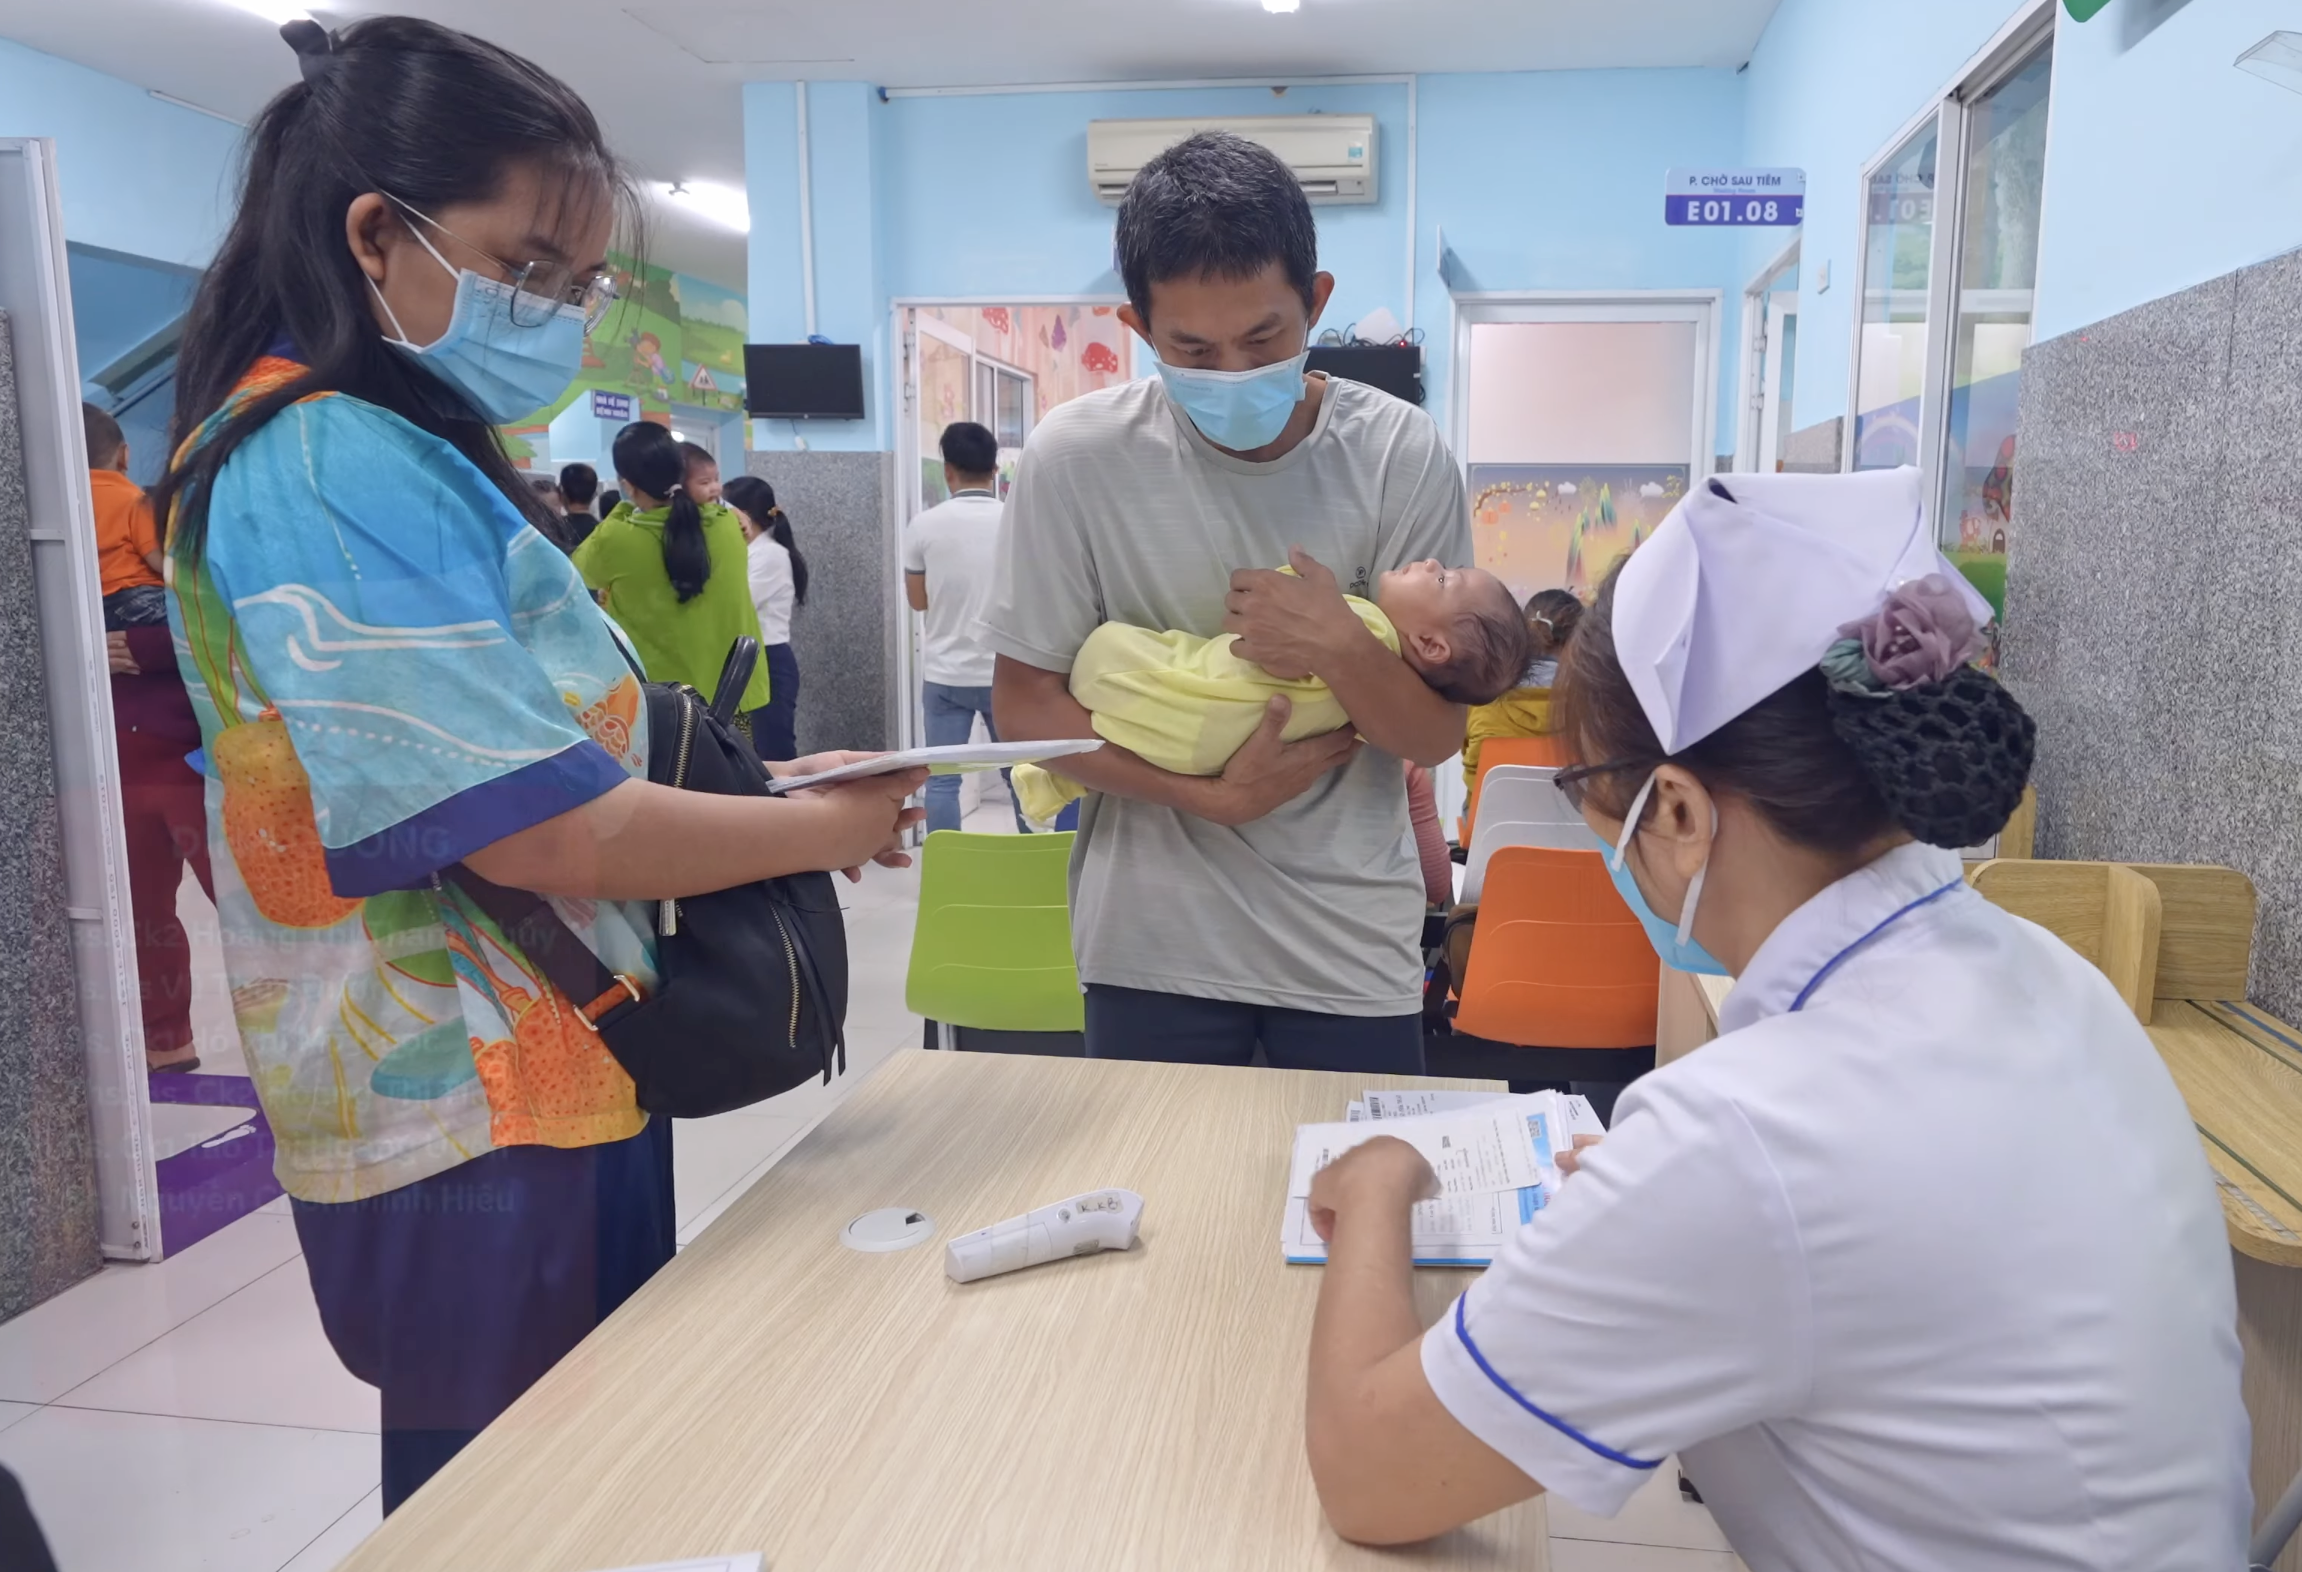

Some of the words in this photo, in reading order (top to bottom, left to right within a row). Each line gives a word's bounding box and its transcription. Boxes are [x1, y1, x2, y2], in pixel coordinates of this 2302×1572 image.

[1689, 176, 1698, 186] P.
[1701, 173, 1728, 186] CHỜ
[1731, 176, 1753, 185] SAU
[1756, 174, 1781, 186] TIÊM
[1687, 200, 1779, 222] E01.08
